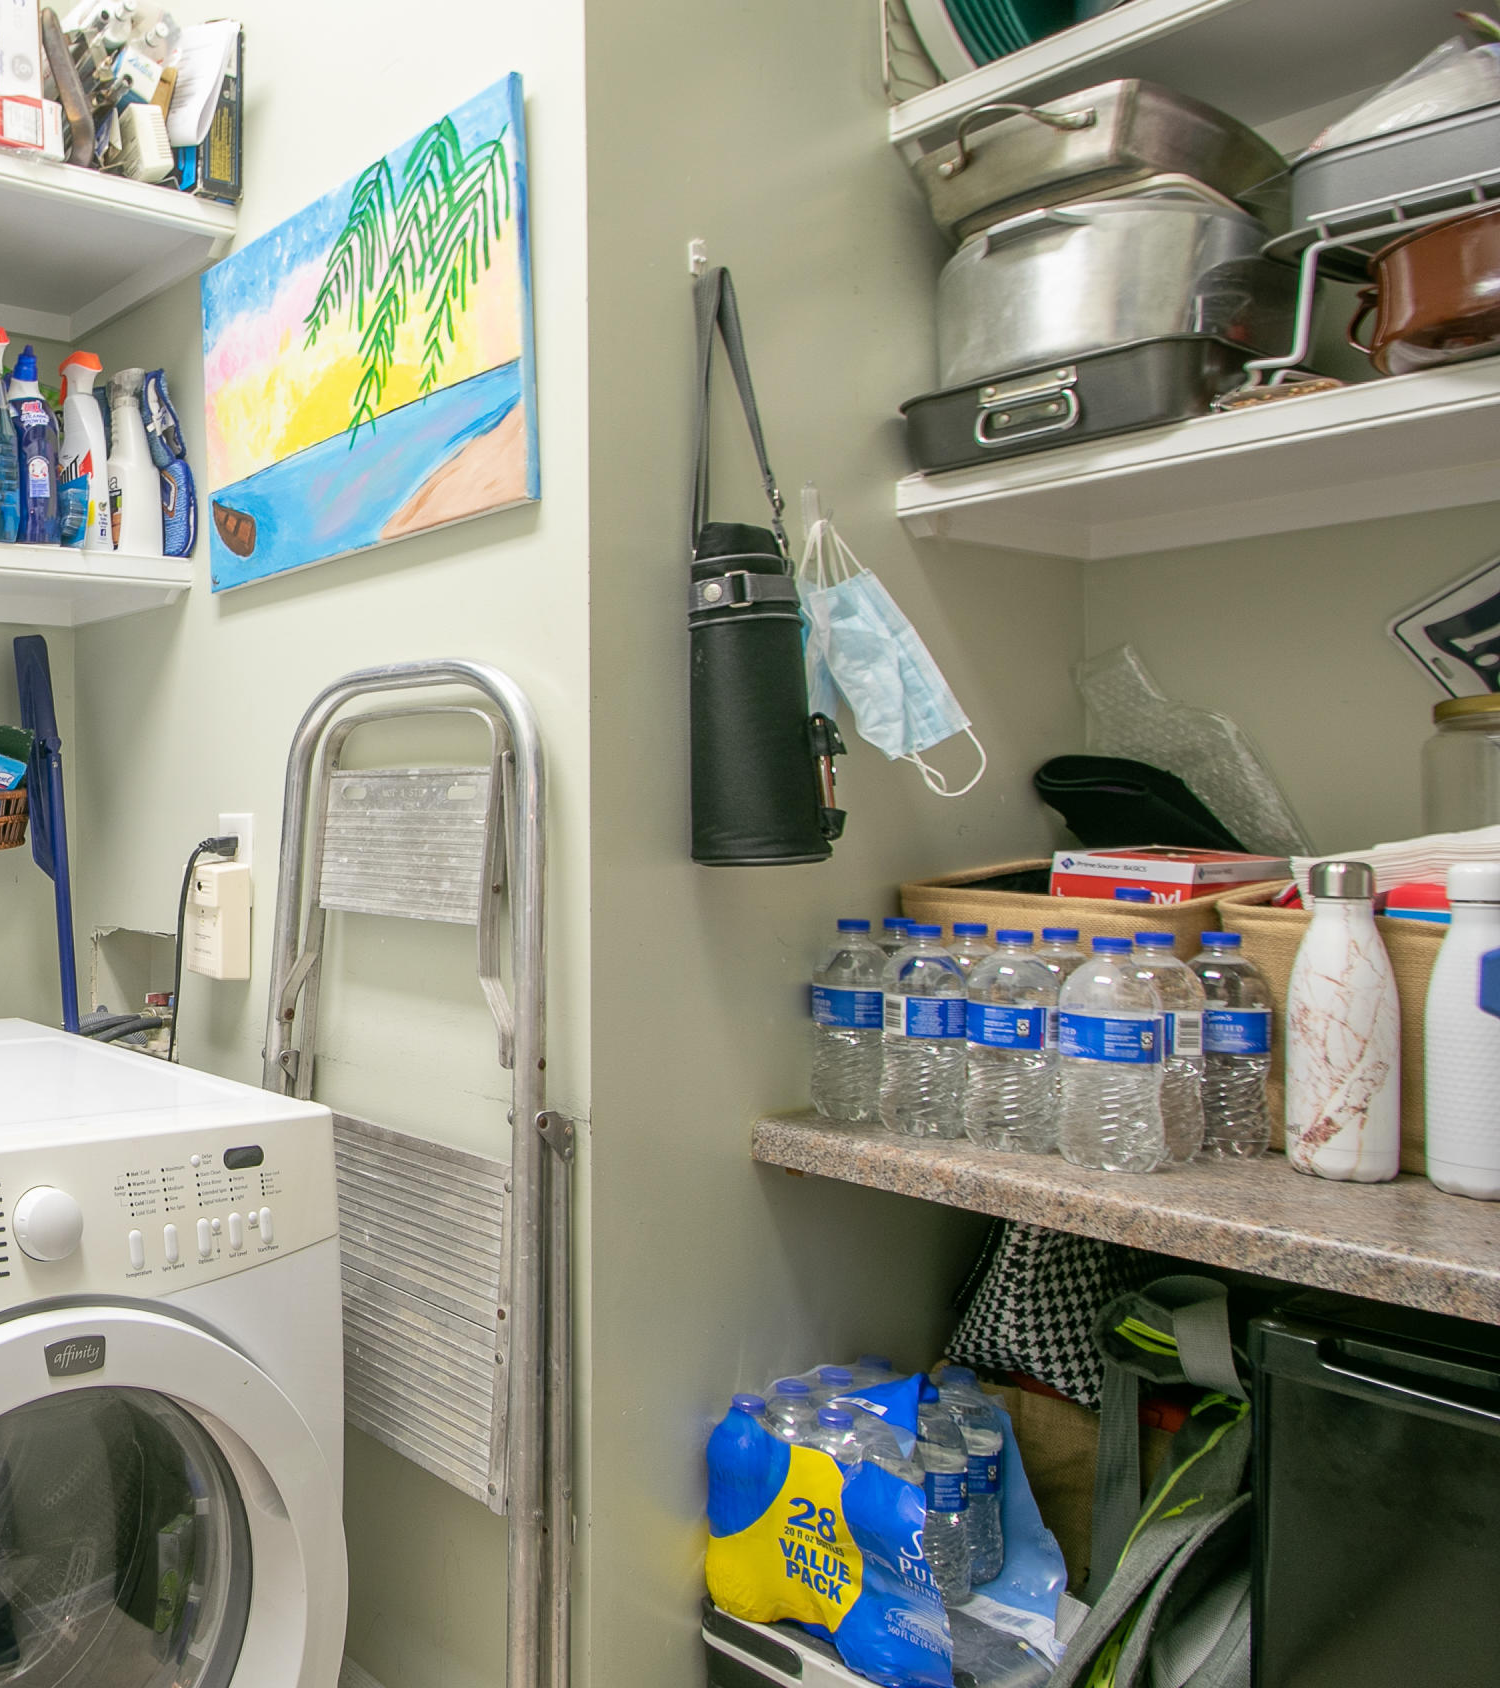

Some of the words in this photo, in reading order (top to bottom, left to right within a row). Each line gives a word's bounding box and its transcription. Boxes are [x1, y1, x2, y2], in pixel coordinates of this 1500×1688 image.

[125, 1269, 153, 1279] Temperature
[53, 1343, 100, 1369] affinity
[784, 1526, 795, 1536] 20
[787, 1497, 837, 1544] 28
[778, 1537, 851, 1585] VALUE
[786, 1559, 843, 1605] PACK
[887, 1623, 900, 1637] 560
